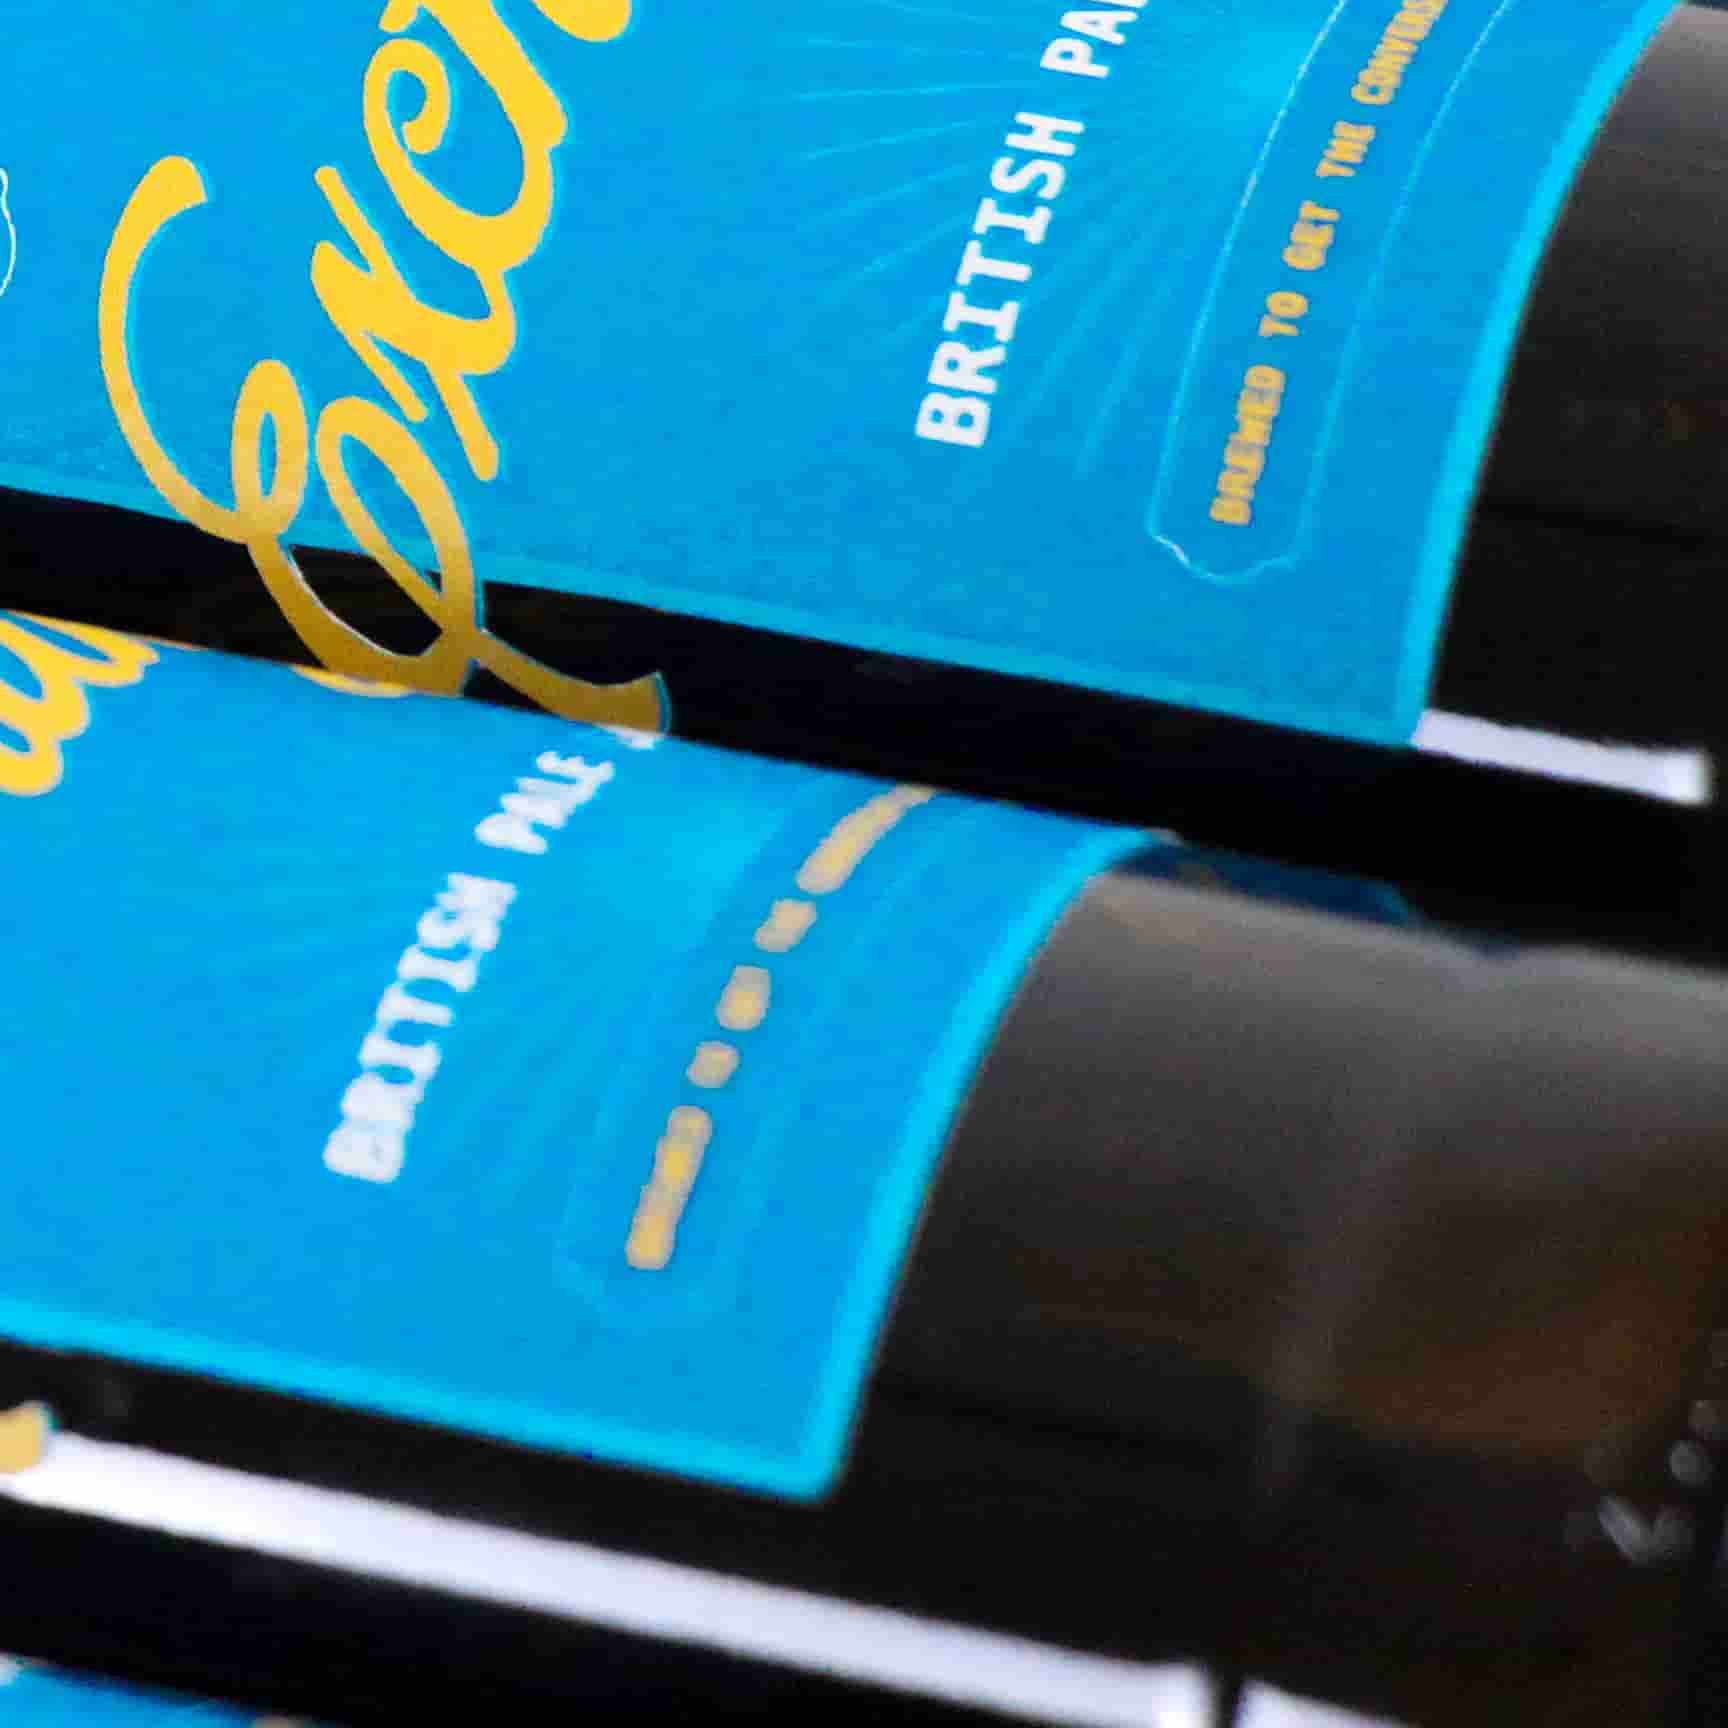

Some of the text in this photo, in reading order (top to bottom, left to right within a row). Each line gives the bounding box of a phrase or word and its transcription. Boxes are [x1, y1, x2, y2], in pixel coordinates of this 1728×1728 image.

[916, 111, 1084, 447] BRITISH
[1259, 291, 1308, 337] TO
[323, 751, 614, 1183] BRITISH PALE
